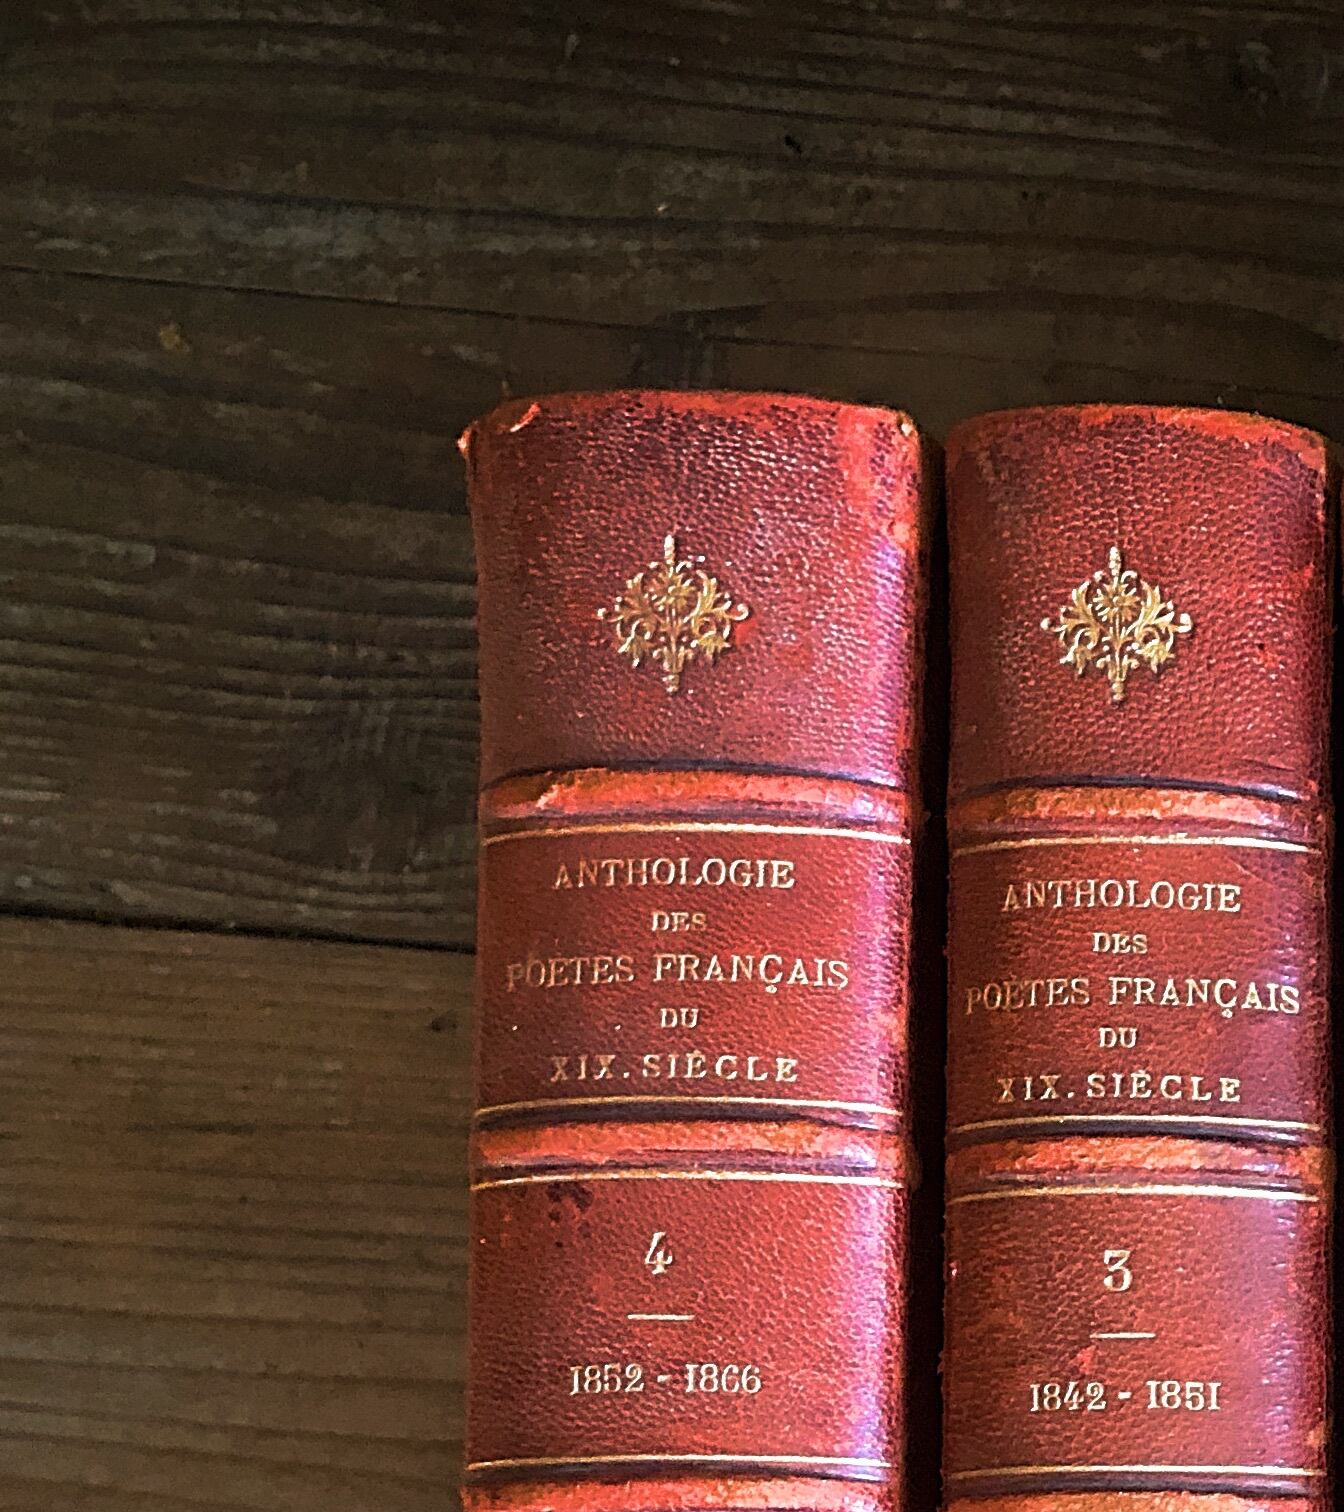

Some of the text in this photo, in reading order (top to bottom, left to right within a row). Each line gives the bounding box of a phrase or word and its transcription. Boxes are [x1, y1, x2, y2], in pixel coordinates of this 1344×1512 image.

[552, 857, 796, 890] ANTHOLOGIE
[1000, 880, 1242, 913] ANTHOLOGIE
[651, 911, 707, 933] DES
[1092, 932, 1149, 955] DES
[652, 953, 850, 993] FRANÇAIS
[1108, 976, 1301, 1019] FRANÇAIS
[660, 1007, 699, 1029] DU
[1098, 1028, 1137, 1049] DU
[641, 1049, 799, 1083] SIÈCLE
[1086, 1069, 1242, 1103] SIÈCLE
[644, 1231, 673, 1275] 4
[1103, 1250, 1133, 1293] 3
